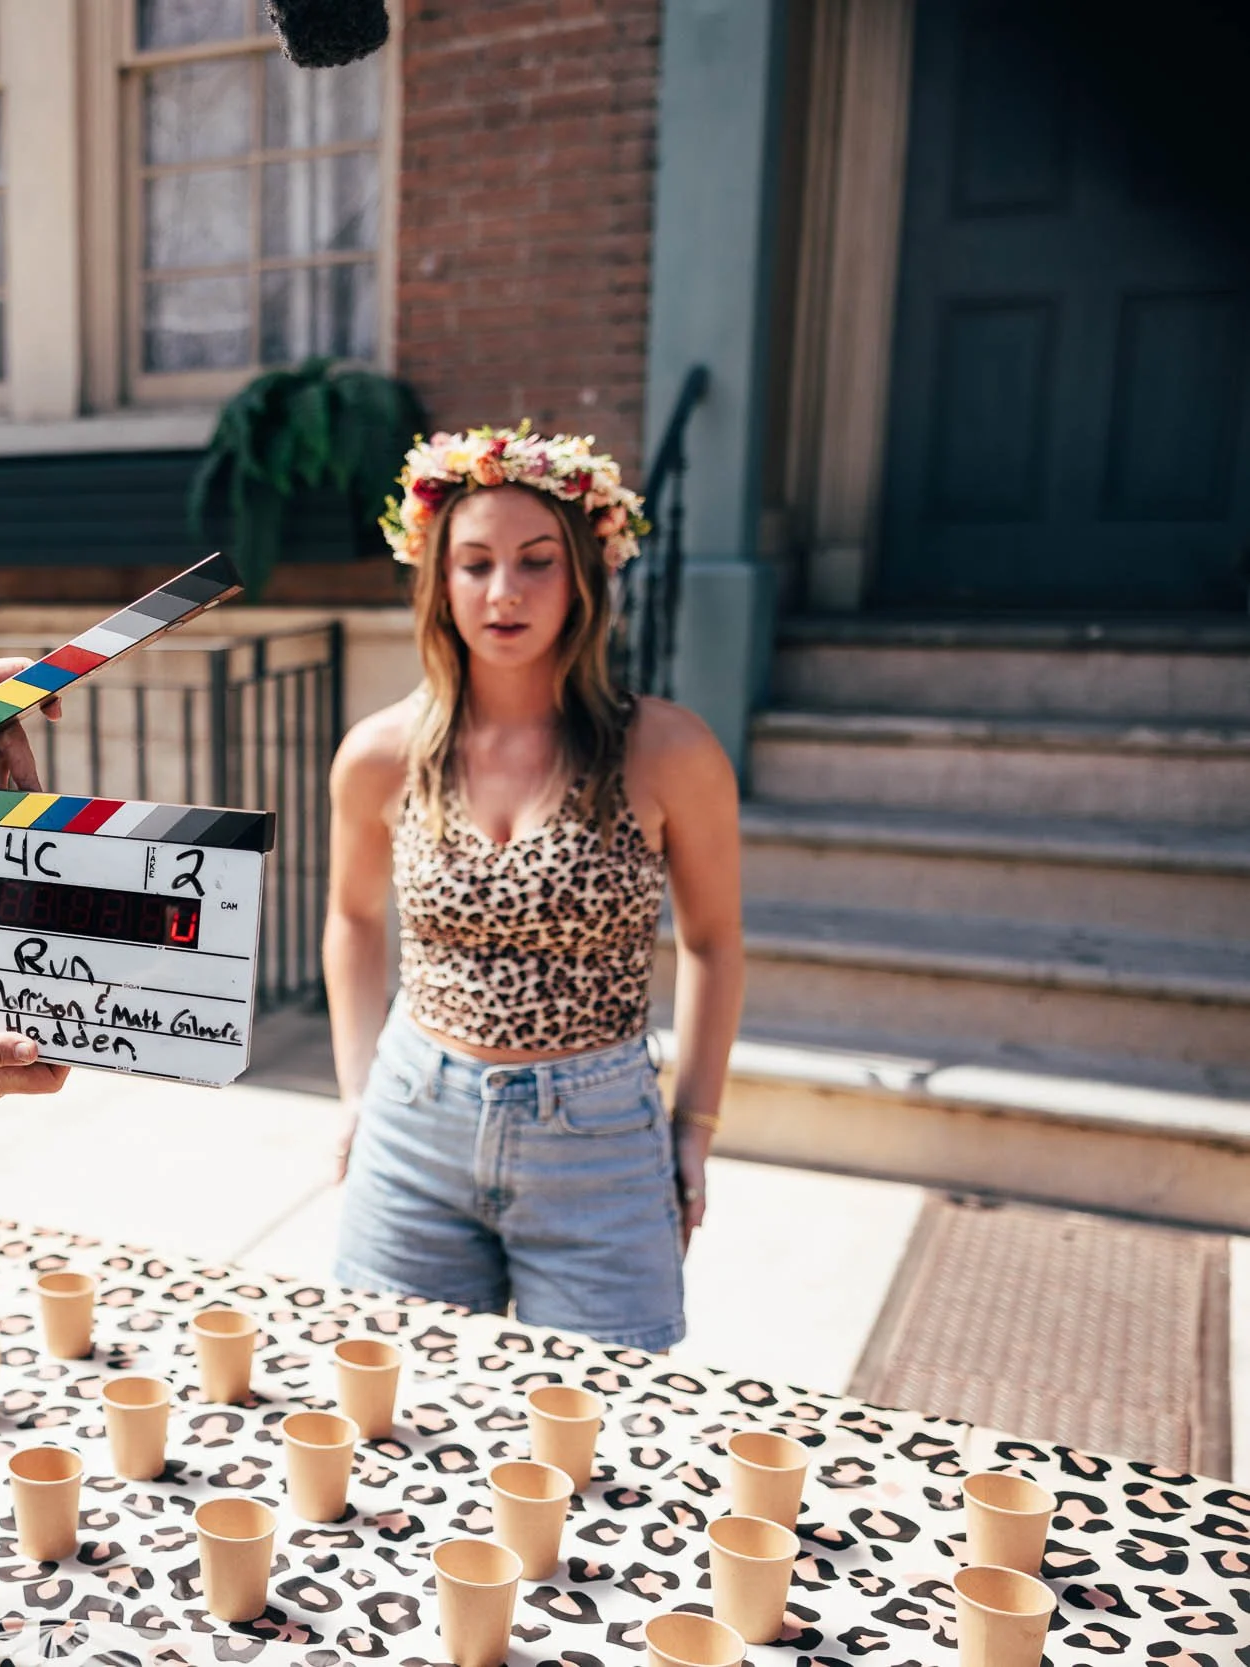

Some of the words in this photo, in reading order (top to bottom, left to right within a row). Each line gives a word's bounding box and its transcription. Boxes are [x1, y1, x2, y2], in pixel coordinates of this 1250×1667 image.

[4, 832, 62, 878] 4C
[149, 846, 157, 879] TAKE
[171, 849, 205, 897] 2
[221, 901, 238, 910] CAM
[111, 1003, 162, 1030] Matt
[6, 1012, 137, 1062] Hadden
